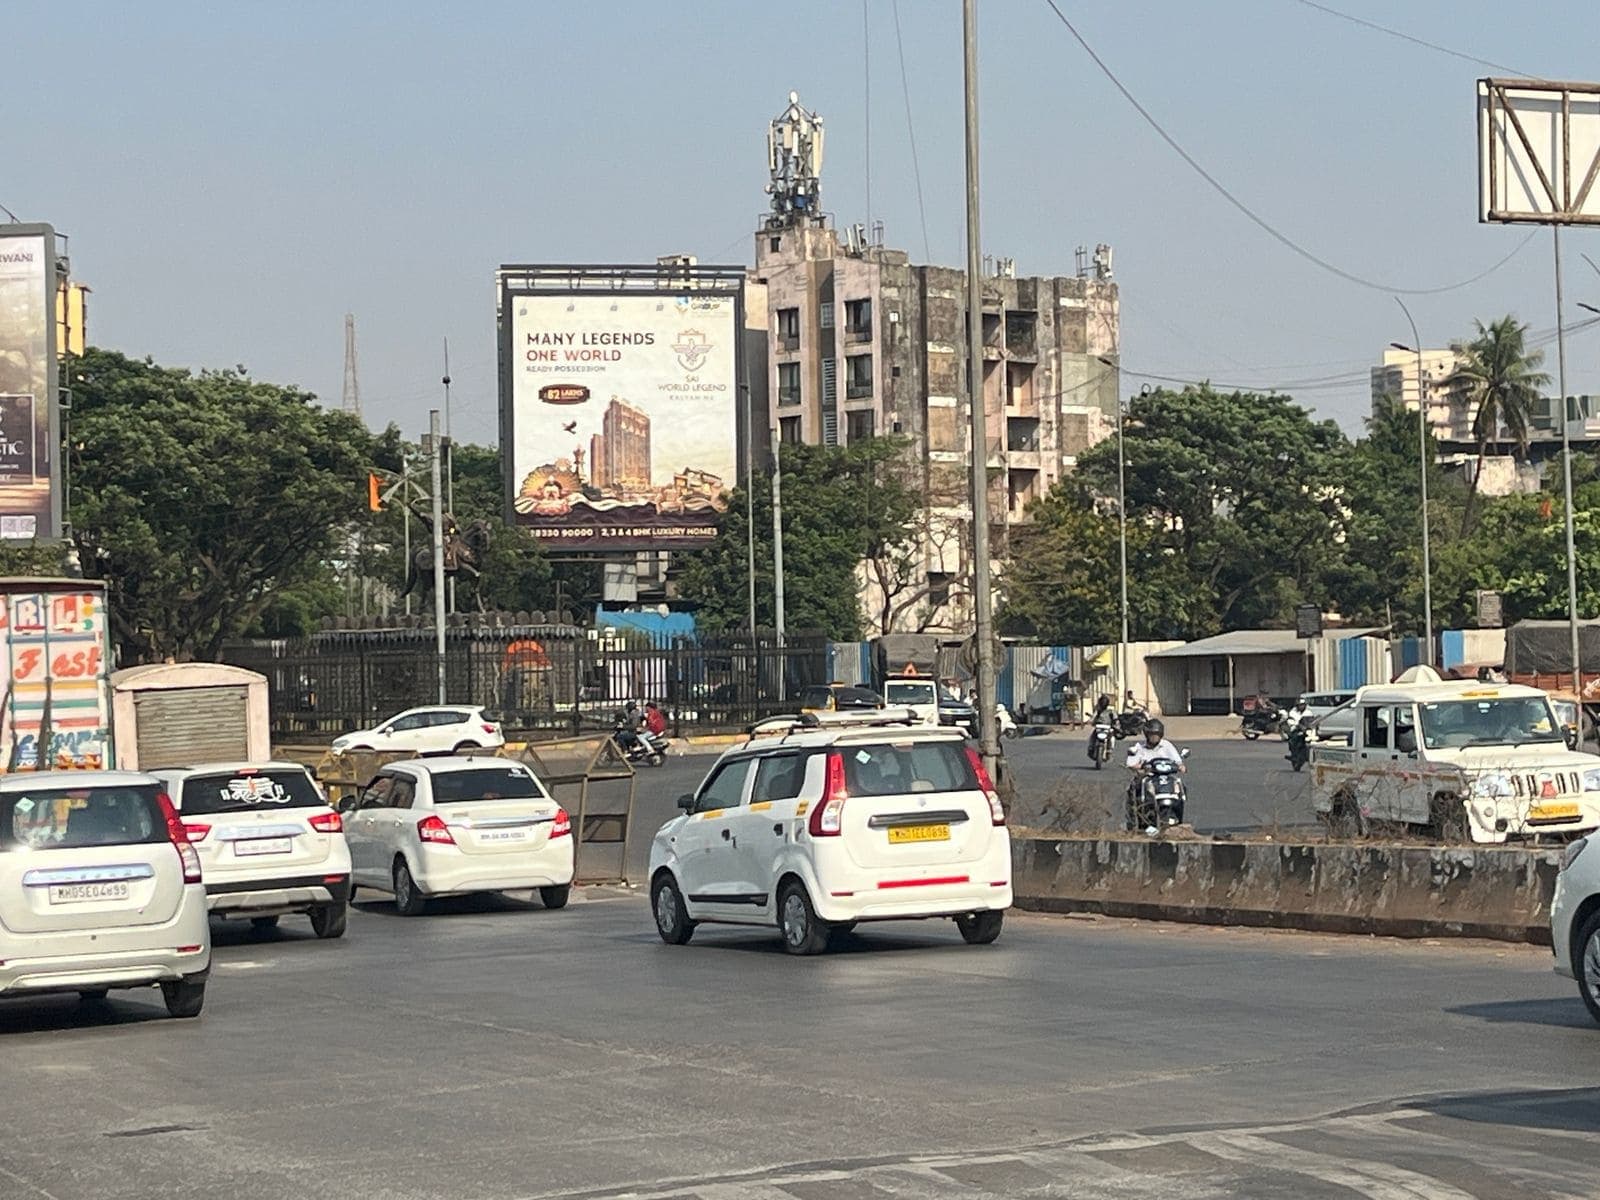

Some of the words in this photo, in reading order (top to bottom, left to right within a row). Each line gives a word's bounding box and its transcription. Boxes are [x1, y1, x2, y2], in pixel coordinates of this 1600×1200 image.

[526, 333, 576, 345] MANY
[582, 332, 656, 345] LEGENDS
[526, 350, 558, 361] ONE
[564, 350, 622, 361] WORLD
[526, 365, 553, 373] READY
[692, 384, 727, 392] LEGEND
[626, 527, 633, 536] 4
[653, 527, 685, 536] LUXURY
[687, 527, 718, 536] HOMES
